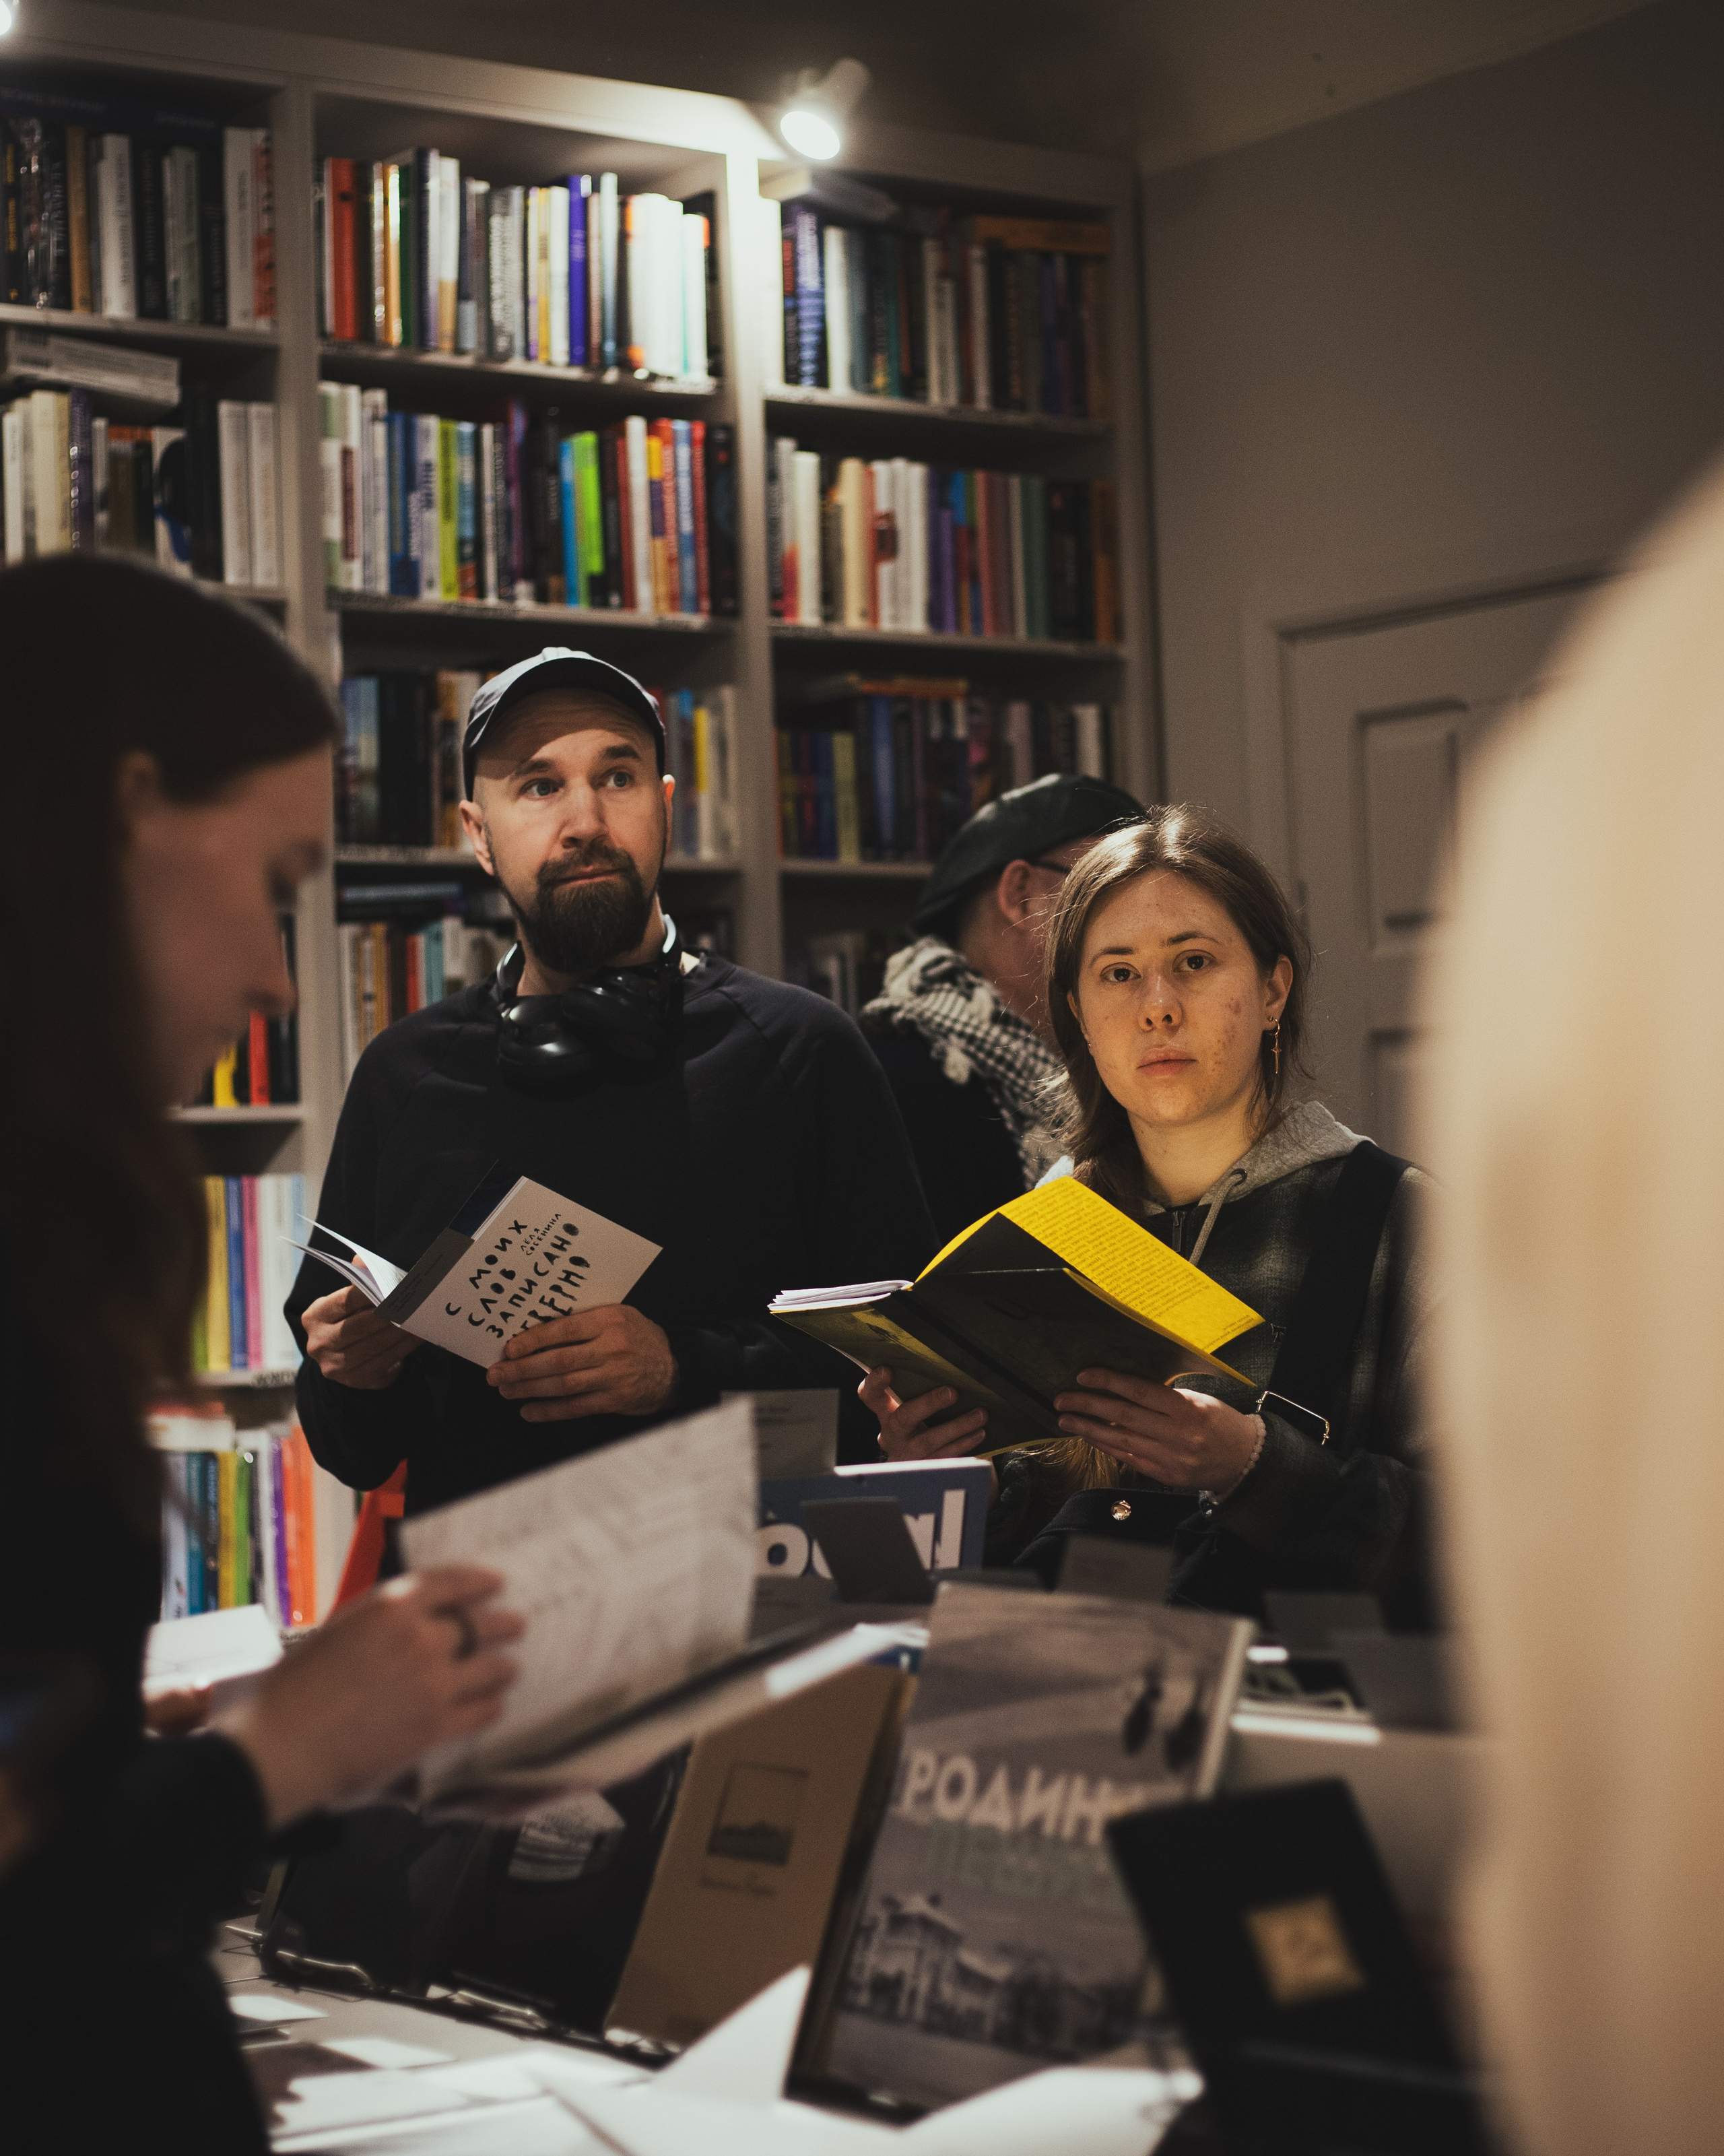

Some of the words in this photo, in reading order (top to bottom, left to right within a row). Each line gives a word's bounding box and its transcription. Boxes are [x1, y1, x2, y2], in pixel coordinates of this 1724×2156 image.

[445, 1303, 462, 1315] С
[469, 1220, 528, 1289] МОИХ
[468, 1268, 516, 1326] СЛОВ
[486, 1223, 579, 1338] ЗАПИСАНО
[506, 1256, 591, 1344] ВЕРНО
[898, 1749, 1113, 1845] РОДИН
